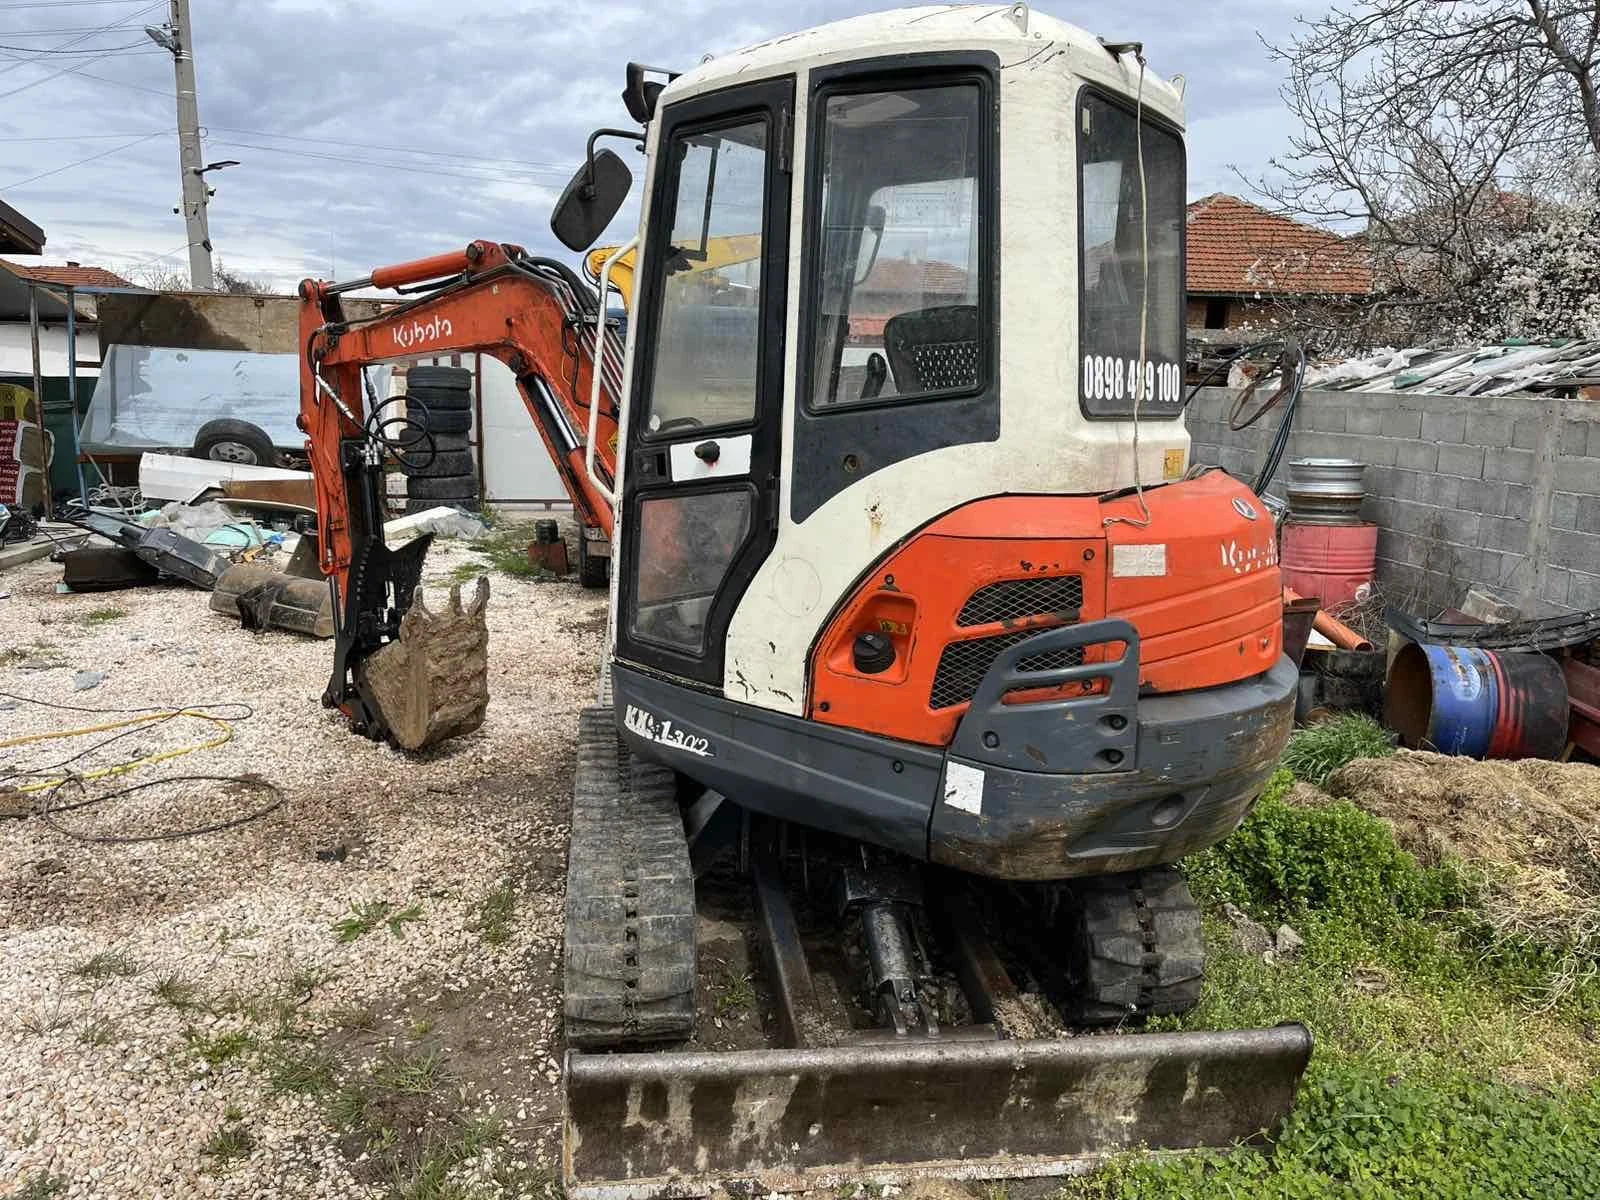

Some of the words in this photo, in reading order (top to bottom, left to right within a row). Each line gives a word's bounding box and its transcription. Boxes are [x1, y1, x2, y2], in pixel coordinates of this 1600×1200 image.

[393, 314, 453, 348] Kubota
[1084, 355, 1124, 401] 0898
[1157, 362, 1180, 402] 100
